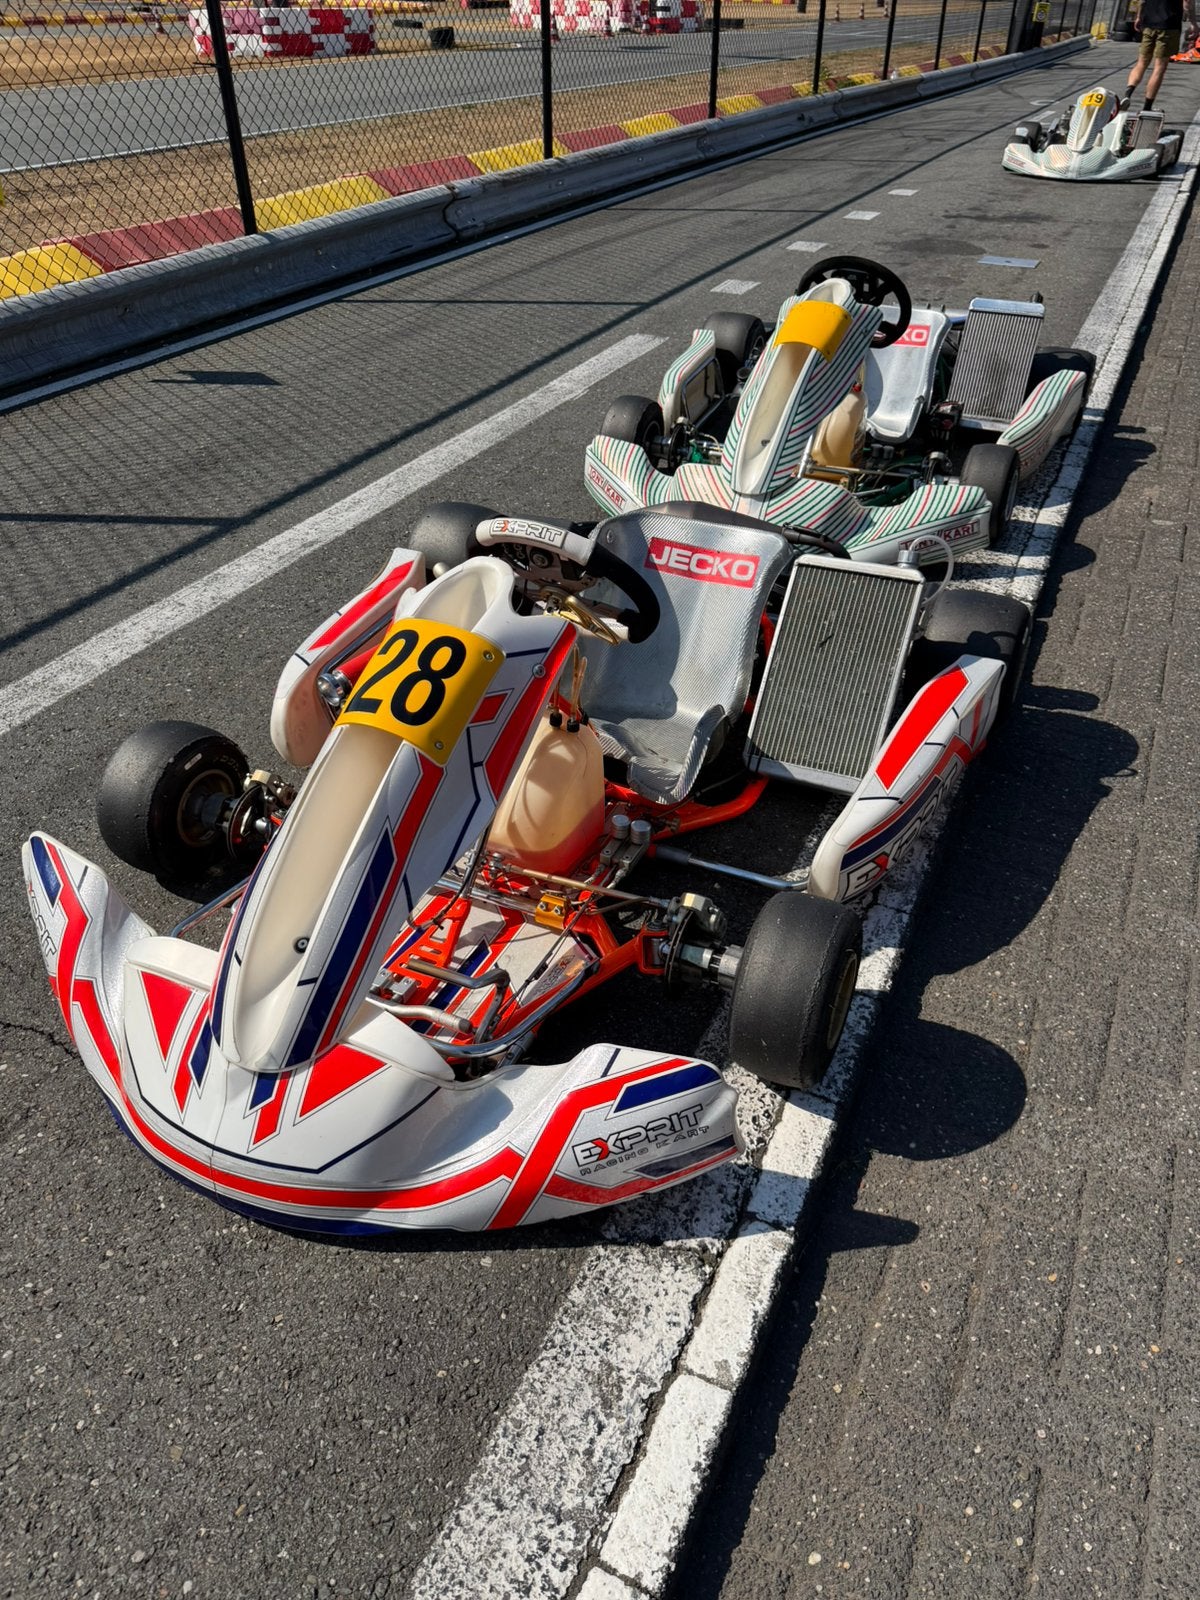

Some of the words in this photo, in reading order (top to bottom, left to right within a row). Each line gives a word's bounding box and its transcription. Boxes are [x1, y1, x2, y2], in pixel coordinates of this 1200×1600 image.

[1088, 93, 1104, 104] 19
[604, 484, 626, 508] KART
[492, 519, 563, 543] EXPRIT
[943, 521, 978, 542] KART
[650, 545, 755, 582] JECKO
[344, 629, 467, 727] 28
[572, 1103, 704, 1168] EXPRIT
[580, 1146, 650, 1177] RACING
[655, 1125, 710, 1149] KART
